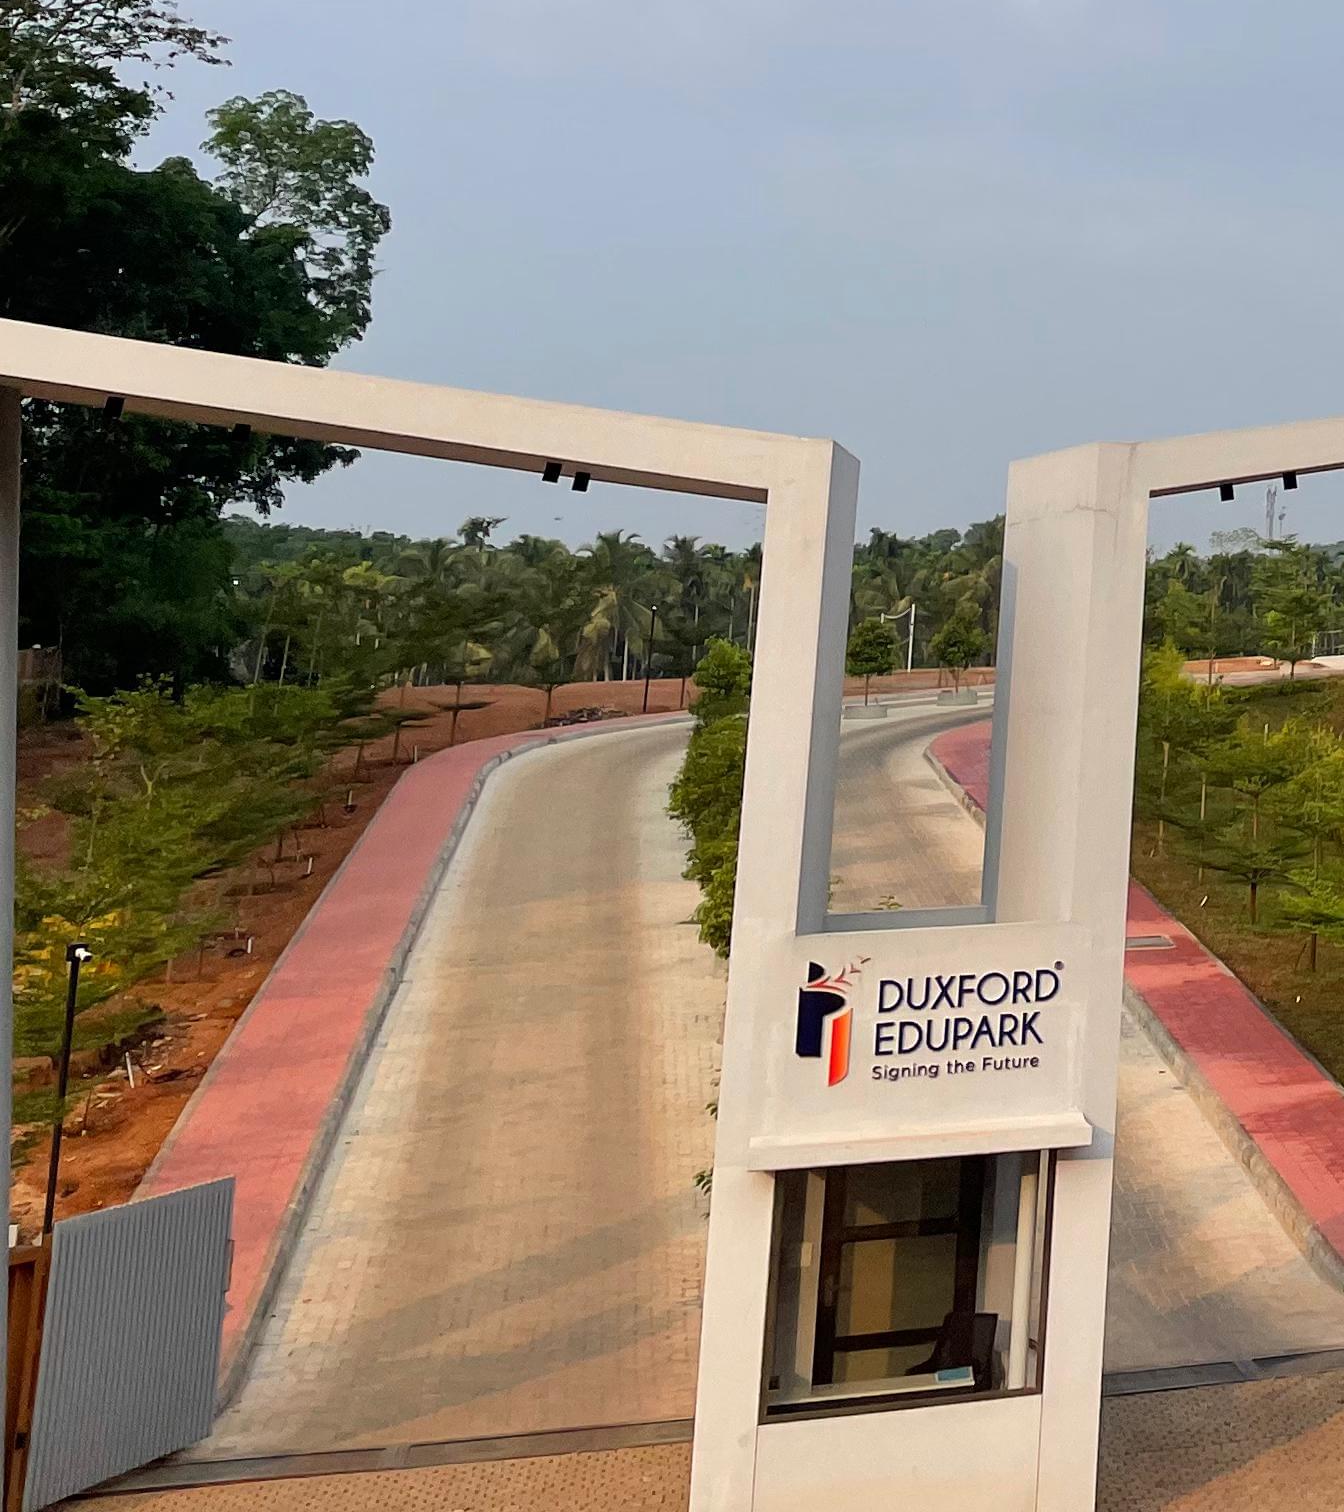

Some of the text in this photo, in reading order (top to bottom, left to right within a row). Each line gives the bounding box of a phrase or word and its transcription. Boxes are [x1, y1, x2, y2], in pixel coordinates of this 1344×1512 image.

[878, 969, 1059, 1013] DUXFORD
[874, 1012, 1043, 1056] EDUPARK
[871, 1055, 1039, 1081] Signing the Future
